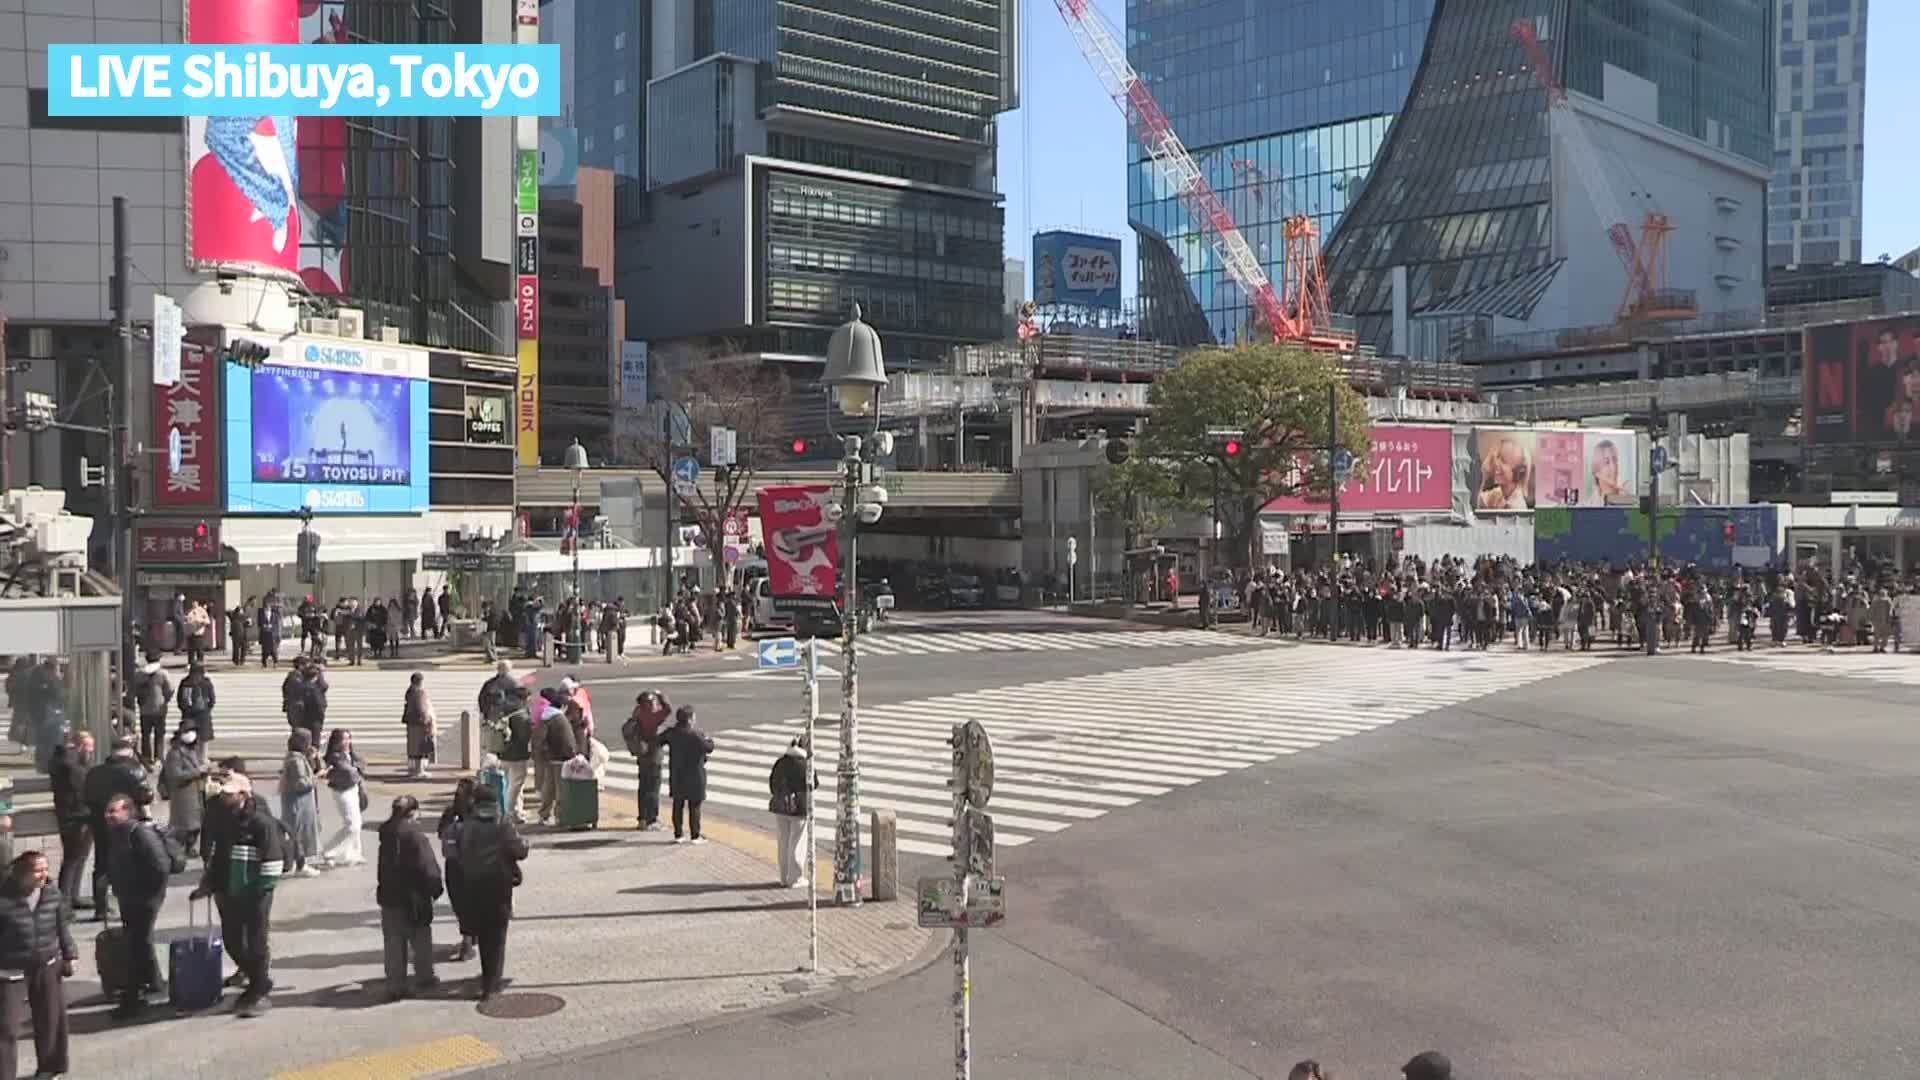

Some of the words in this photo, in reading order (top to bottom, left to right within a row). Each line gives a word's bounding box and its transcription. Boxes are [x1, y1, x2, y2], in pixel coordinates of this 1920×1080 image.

[521, 374, 537, 431] プロミス
[321, 465, 379, 480] TOYOSU
[381, 467, 406, 482] PIT
[142, 536, 213, 552] 天津甘
